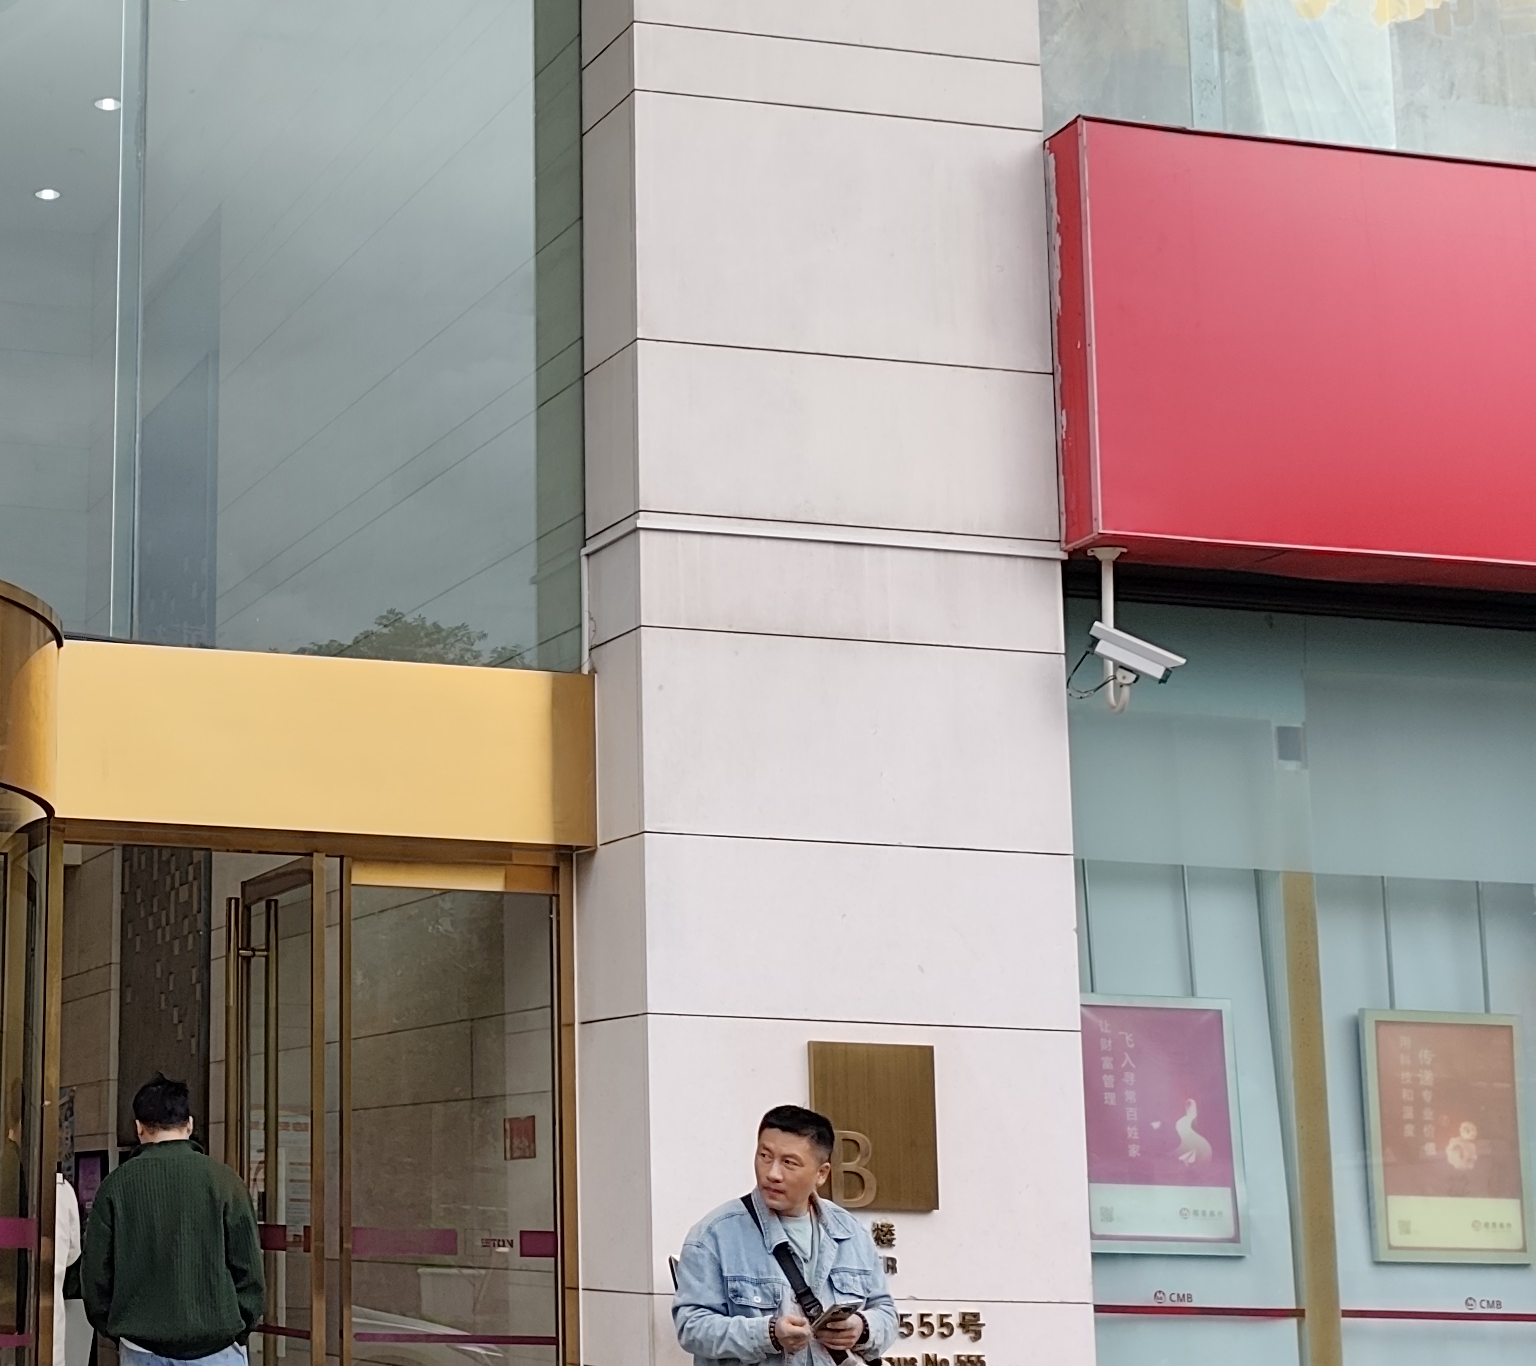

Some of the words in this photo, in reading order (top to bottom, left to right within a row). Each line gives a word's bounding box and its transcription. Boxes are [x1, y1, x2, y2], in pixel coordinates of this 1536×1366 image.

[1098, 1019, 1117, 1106] 让财富管理
[1118, 1031, 1141, 1158] 飞入寻常百姓家
[831, 1130, 877, 1208] B
[1169, 1292, 1193, 1303] CMB
[1479, 1299, 1502, 1310] CMB
[898, 1311, 986, 1342] 555号
